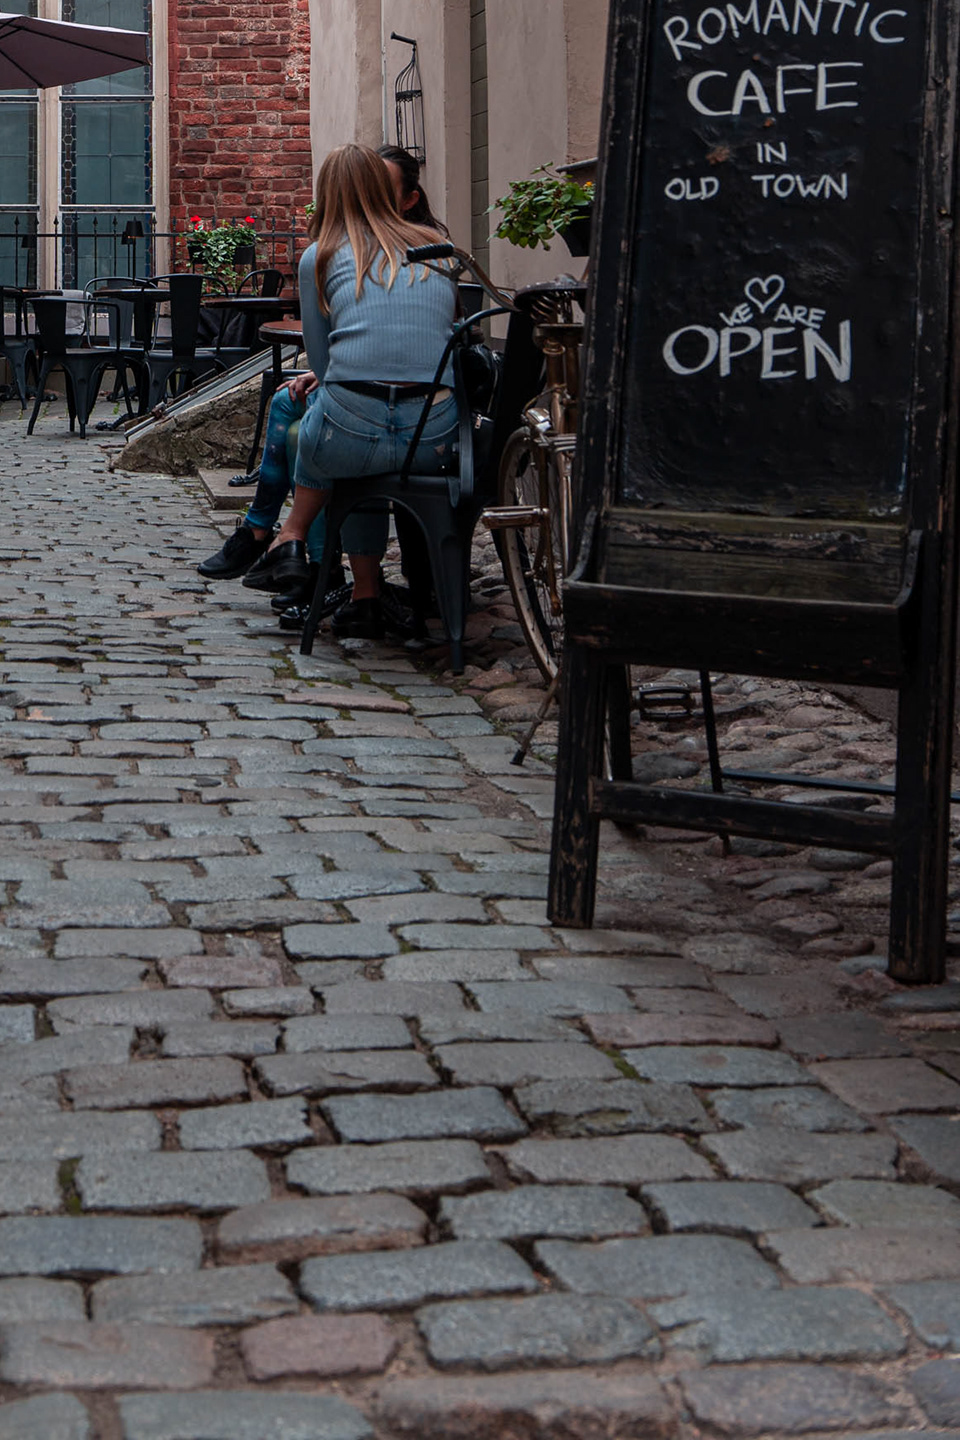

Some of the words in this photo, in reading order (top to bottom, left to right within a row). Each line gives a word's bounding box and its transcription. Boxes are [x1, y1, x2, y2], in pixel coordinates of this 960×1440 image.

[687, 61, 864, 117] CAFE
[756, 141, 788, 164] IN
[664, 176, 720, 201] OLD
[751, 172, 848, 200] TOWN
[719, 302, 754, 327] WE
[773, 303, 826, 330] ARE
[662, 319, 851, 382] OPEN
